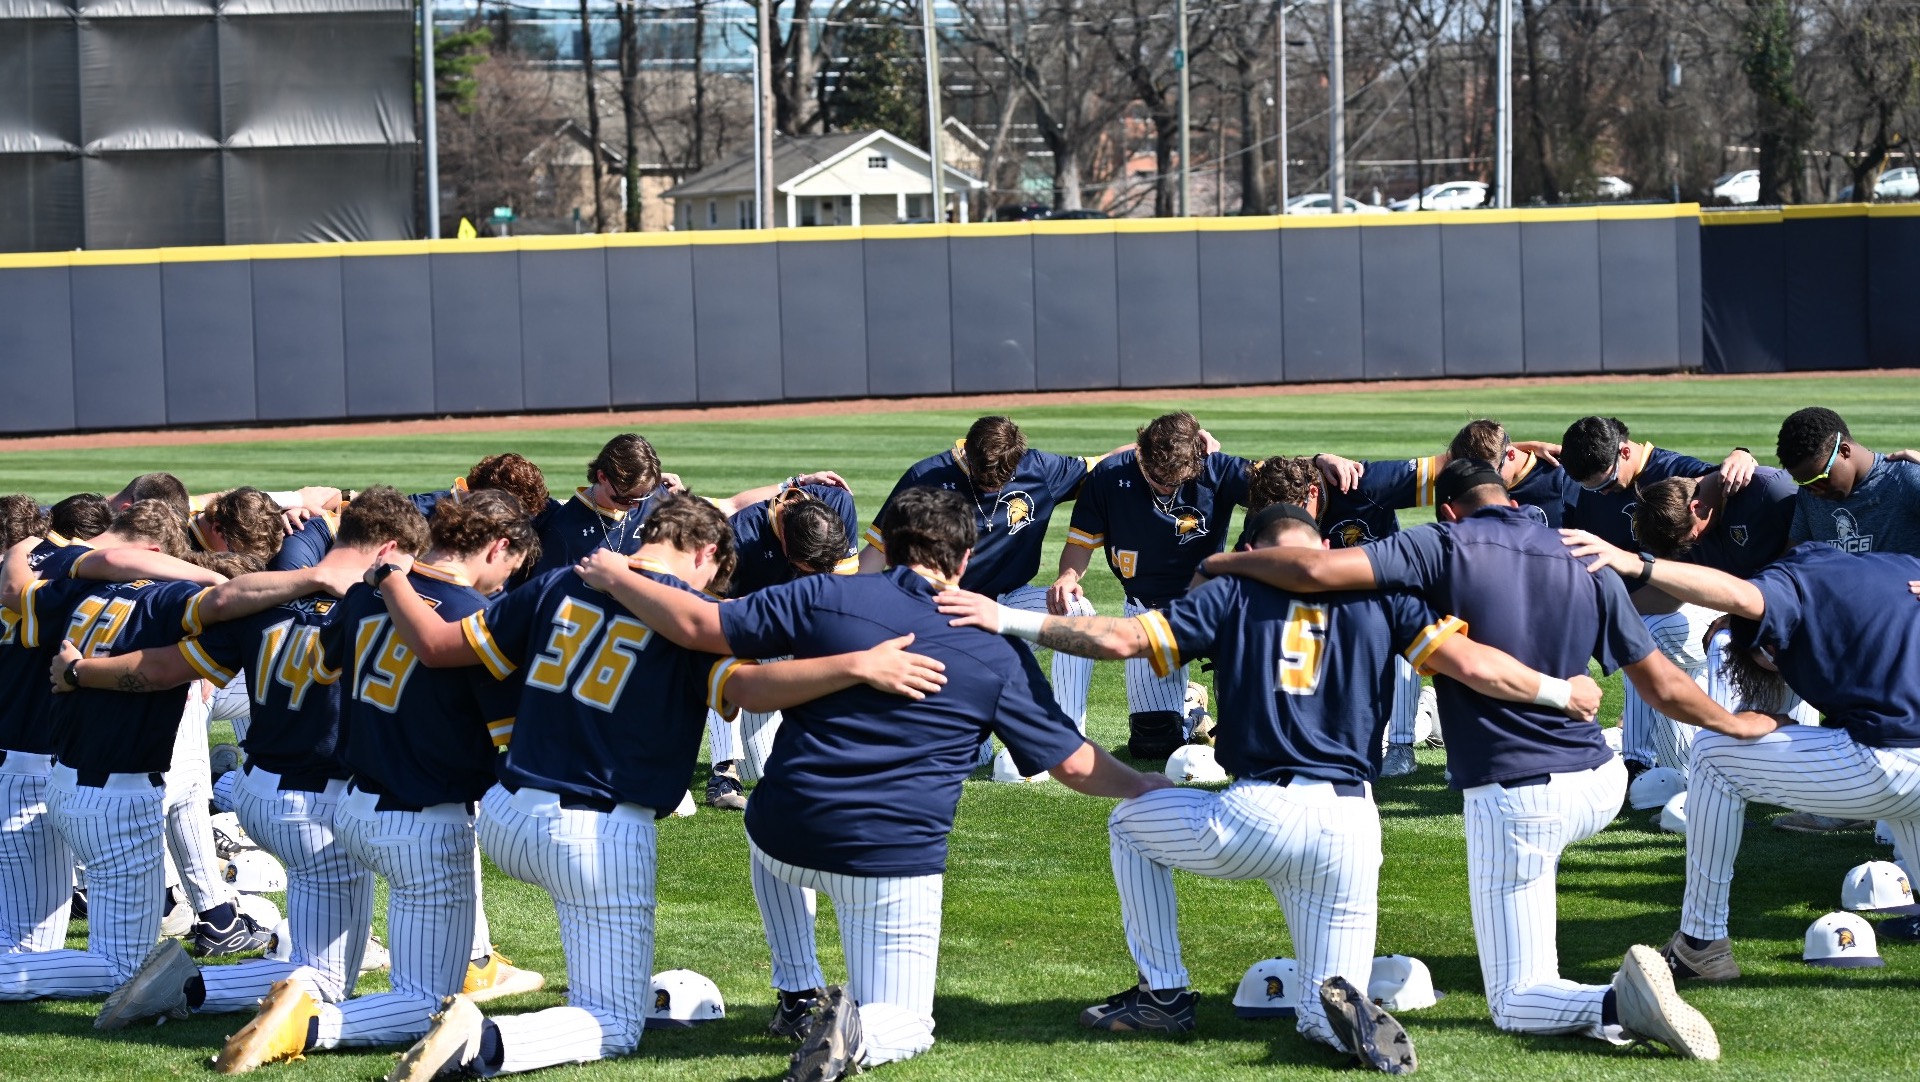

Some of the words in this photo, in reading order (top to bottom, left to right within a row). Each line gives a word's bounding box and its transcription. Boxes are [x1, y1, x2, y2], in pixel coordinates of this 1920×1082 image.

[255, 617, 321, 712] 14
[352, 612, 420, 714] 19
[525, 595, 655, 713] 36
[1273, 599, 1329, 696] 5
